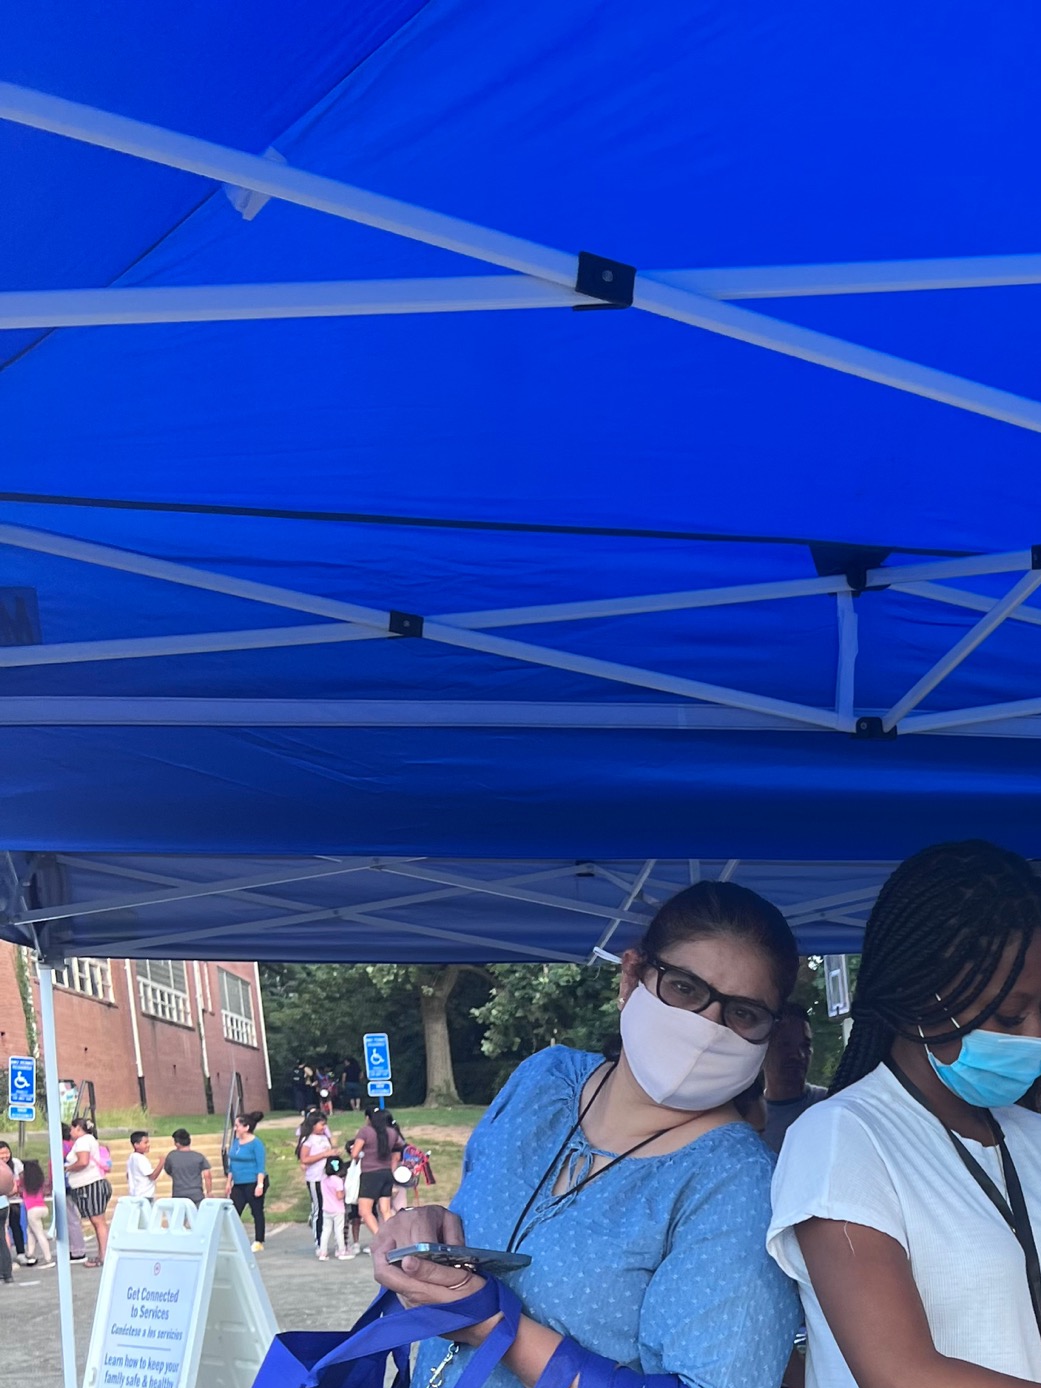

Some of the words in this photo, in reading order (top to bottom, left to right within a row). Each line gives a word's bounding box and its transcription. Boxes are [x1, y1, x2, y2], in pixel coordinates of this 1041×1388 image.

[127, 1286, 140, 1300] Get
[141, 1287, 180, 1303] Connected
[130, 1304, 138, 1318] to
[140, 1304, 169, 1320] Services
[104, 1352, 123, 1367] Learn
[124, 1354, 139, 1369] how
[139, 1356, 147, 1370] to
[147, 1357, 164, 1374] keep
[164, 1362, 180, 1375] your
[104, 1370, 125, 1388] family
[125, 1373, 140, 1388] safe
[141, 1374, 148, 1388] &
